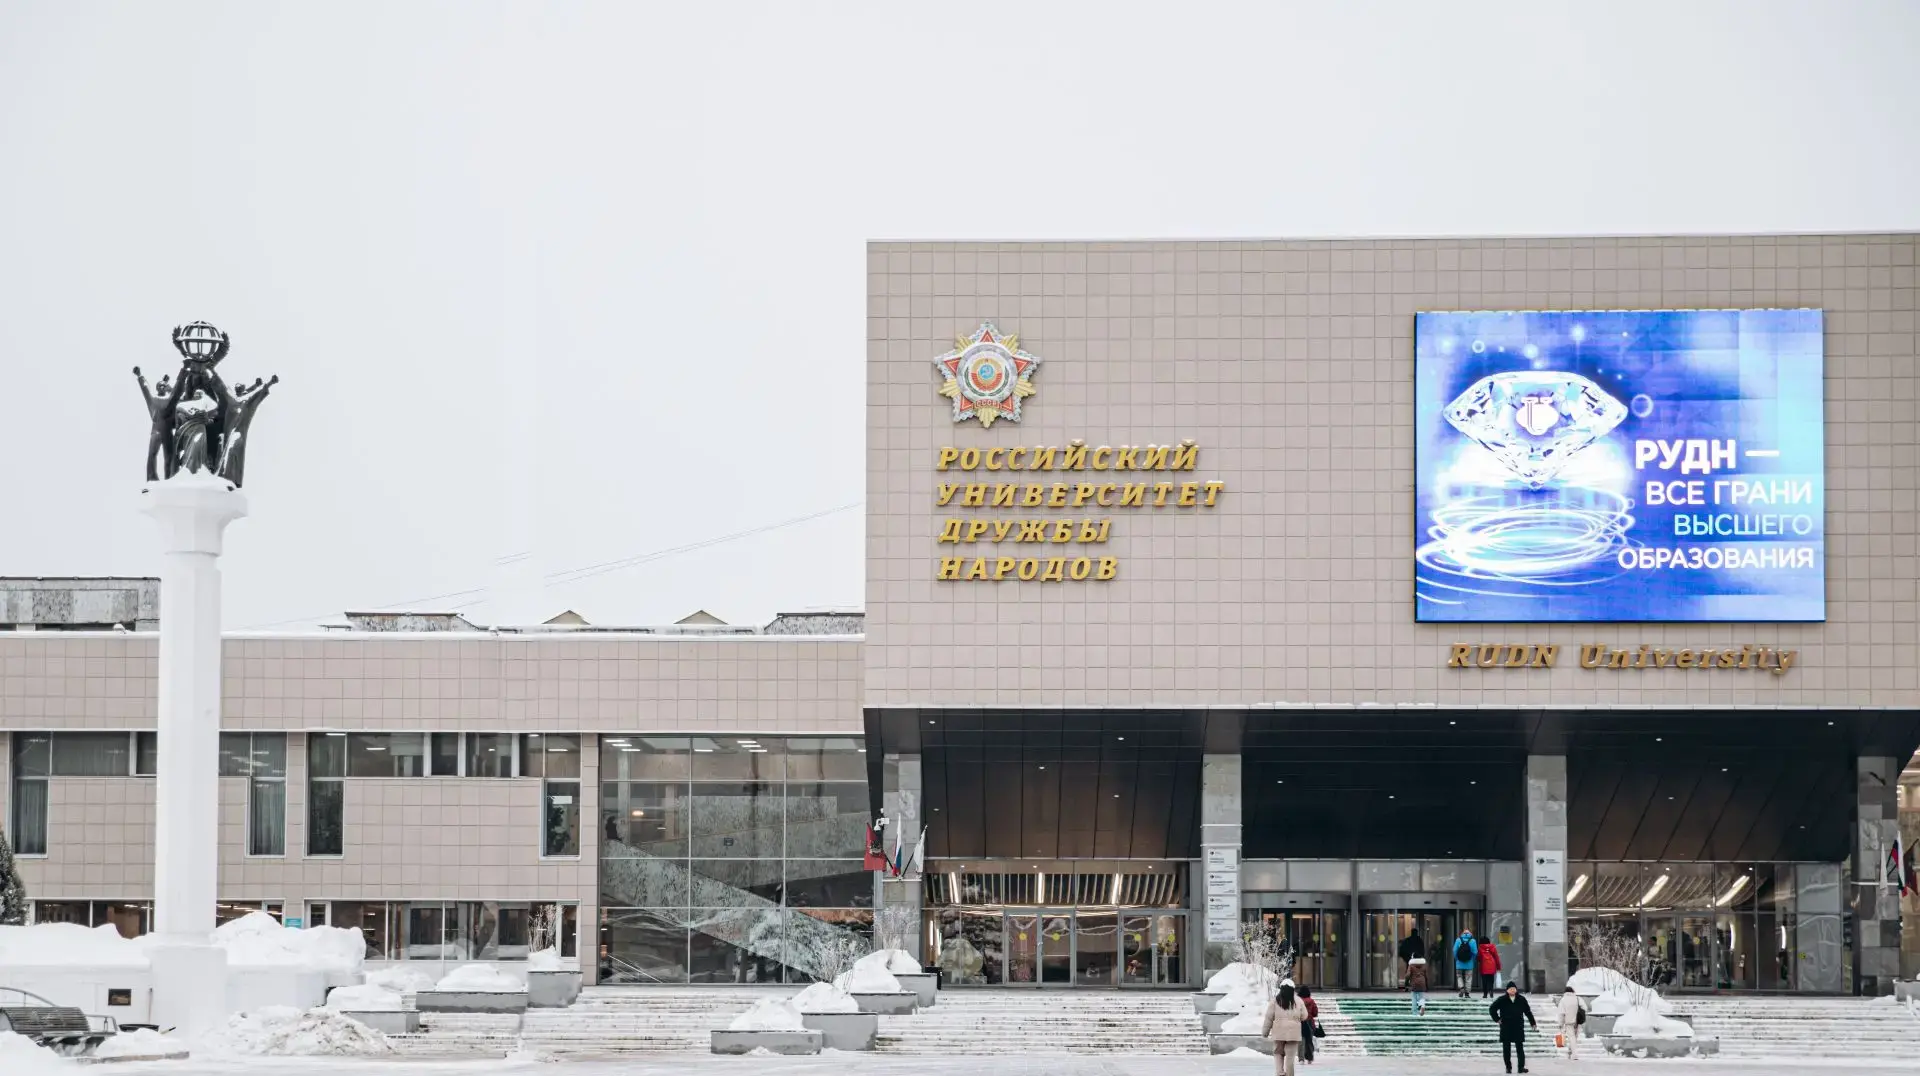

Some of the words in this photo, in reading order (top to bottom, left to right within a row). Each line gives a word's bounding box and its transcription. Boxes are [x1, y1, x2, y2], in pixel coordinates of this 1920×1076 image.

[937, 438, 1199, 471] РОССИЙСКИЙ
[1635, 439, 1736, 475] РУДН
[937, 480, 1225, 508] УНИВЕРСИТЕТ
[1646, 481, 1705, 506] ВСЕ
[1714, 480, 1812, 505] ГРАНИ
[938, 519, 1111, 543] ДРУЖБЫ
[1674, 514, 1812, 536] ВЫСШЕГО
[937, 556, 1118, 582] НАРОДОВ
[1618, 547, 1814, 570] ОБРАЗОВАНИЯ
[1448, 643, 1560, 669] RUDN
[1580, 643, 1797, 674] University
